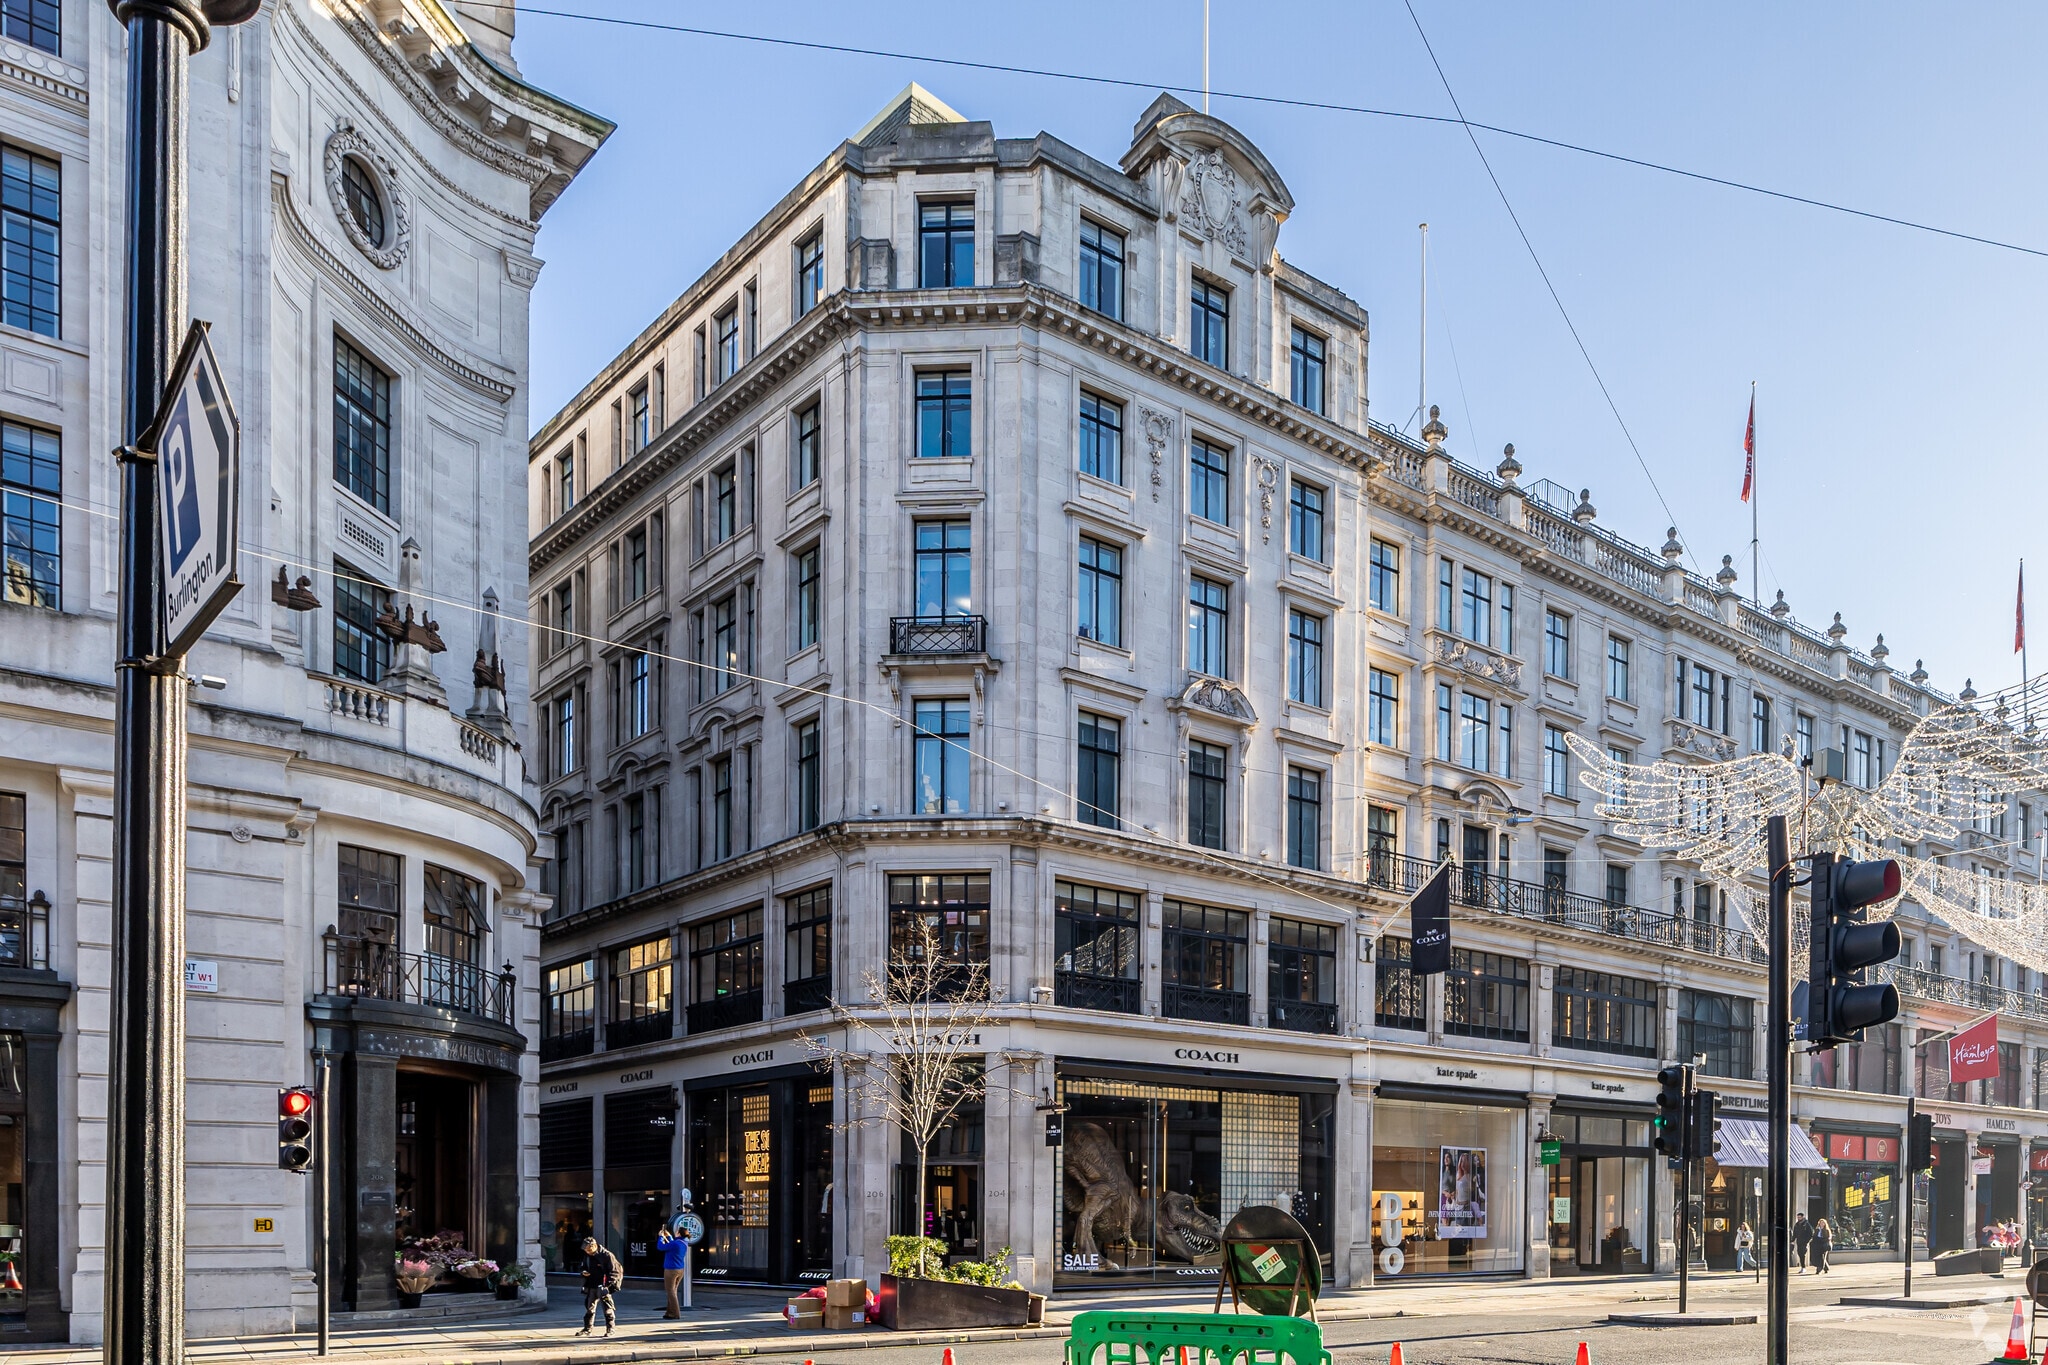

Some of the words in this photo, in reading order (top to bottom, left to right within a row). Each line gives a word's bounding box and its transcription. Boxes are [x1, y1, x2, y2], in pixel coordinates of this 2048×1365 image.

[169, 552, 213, 625] Burlington
[1416, 932, 1447, 945] COACH
[198, 973, 212, 982] W1
[732, 1049, 775, 1067] COACH
[1174, 1048, 1240, 1064] COACH
[1953, 1042, 1996, 1065] Hamleys
[620, 1069, 654, 1084] COACH
[1436, 1066, 1454, 1077] kate
[1455, 1068, 1478, 1081] spade
[549, 1082, 578, 1095] COACH
[1591, 1081, 1605, 1091] kate
[1606, 1082, 1625, 1094] spade
[1721, 1095, 1769, 1110] BREITLING
[1935, 1113, 1952, 1125] TOYS
[1986, 1118, 2016, 1131] HAMLEYS
[744, 1131, 760, 1152] THE
[988, 1190, 1006, 1198] 204
[1379, 1193, 1405, 1275] DUO
[630, 1242, 647, 1253] SALE
[1064, 1253, 1099, 1267] SALE
[799, 1271, 832, 1279] COACH
[1176, 1268, 1220, 1276] COACH
